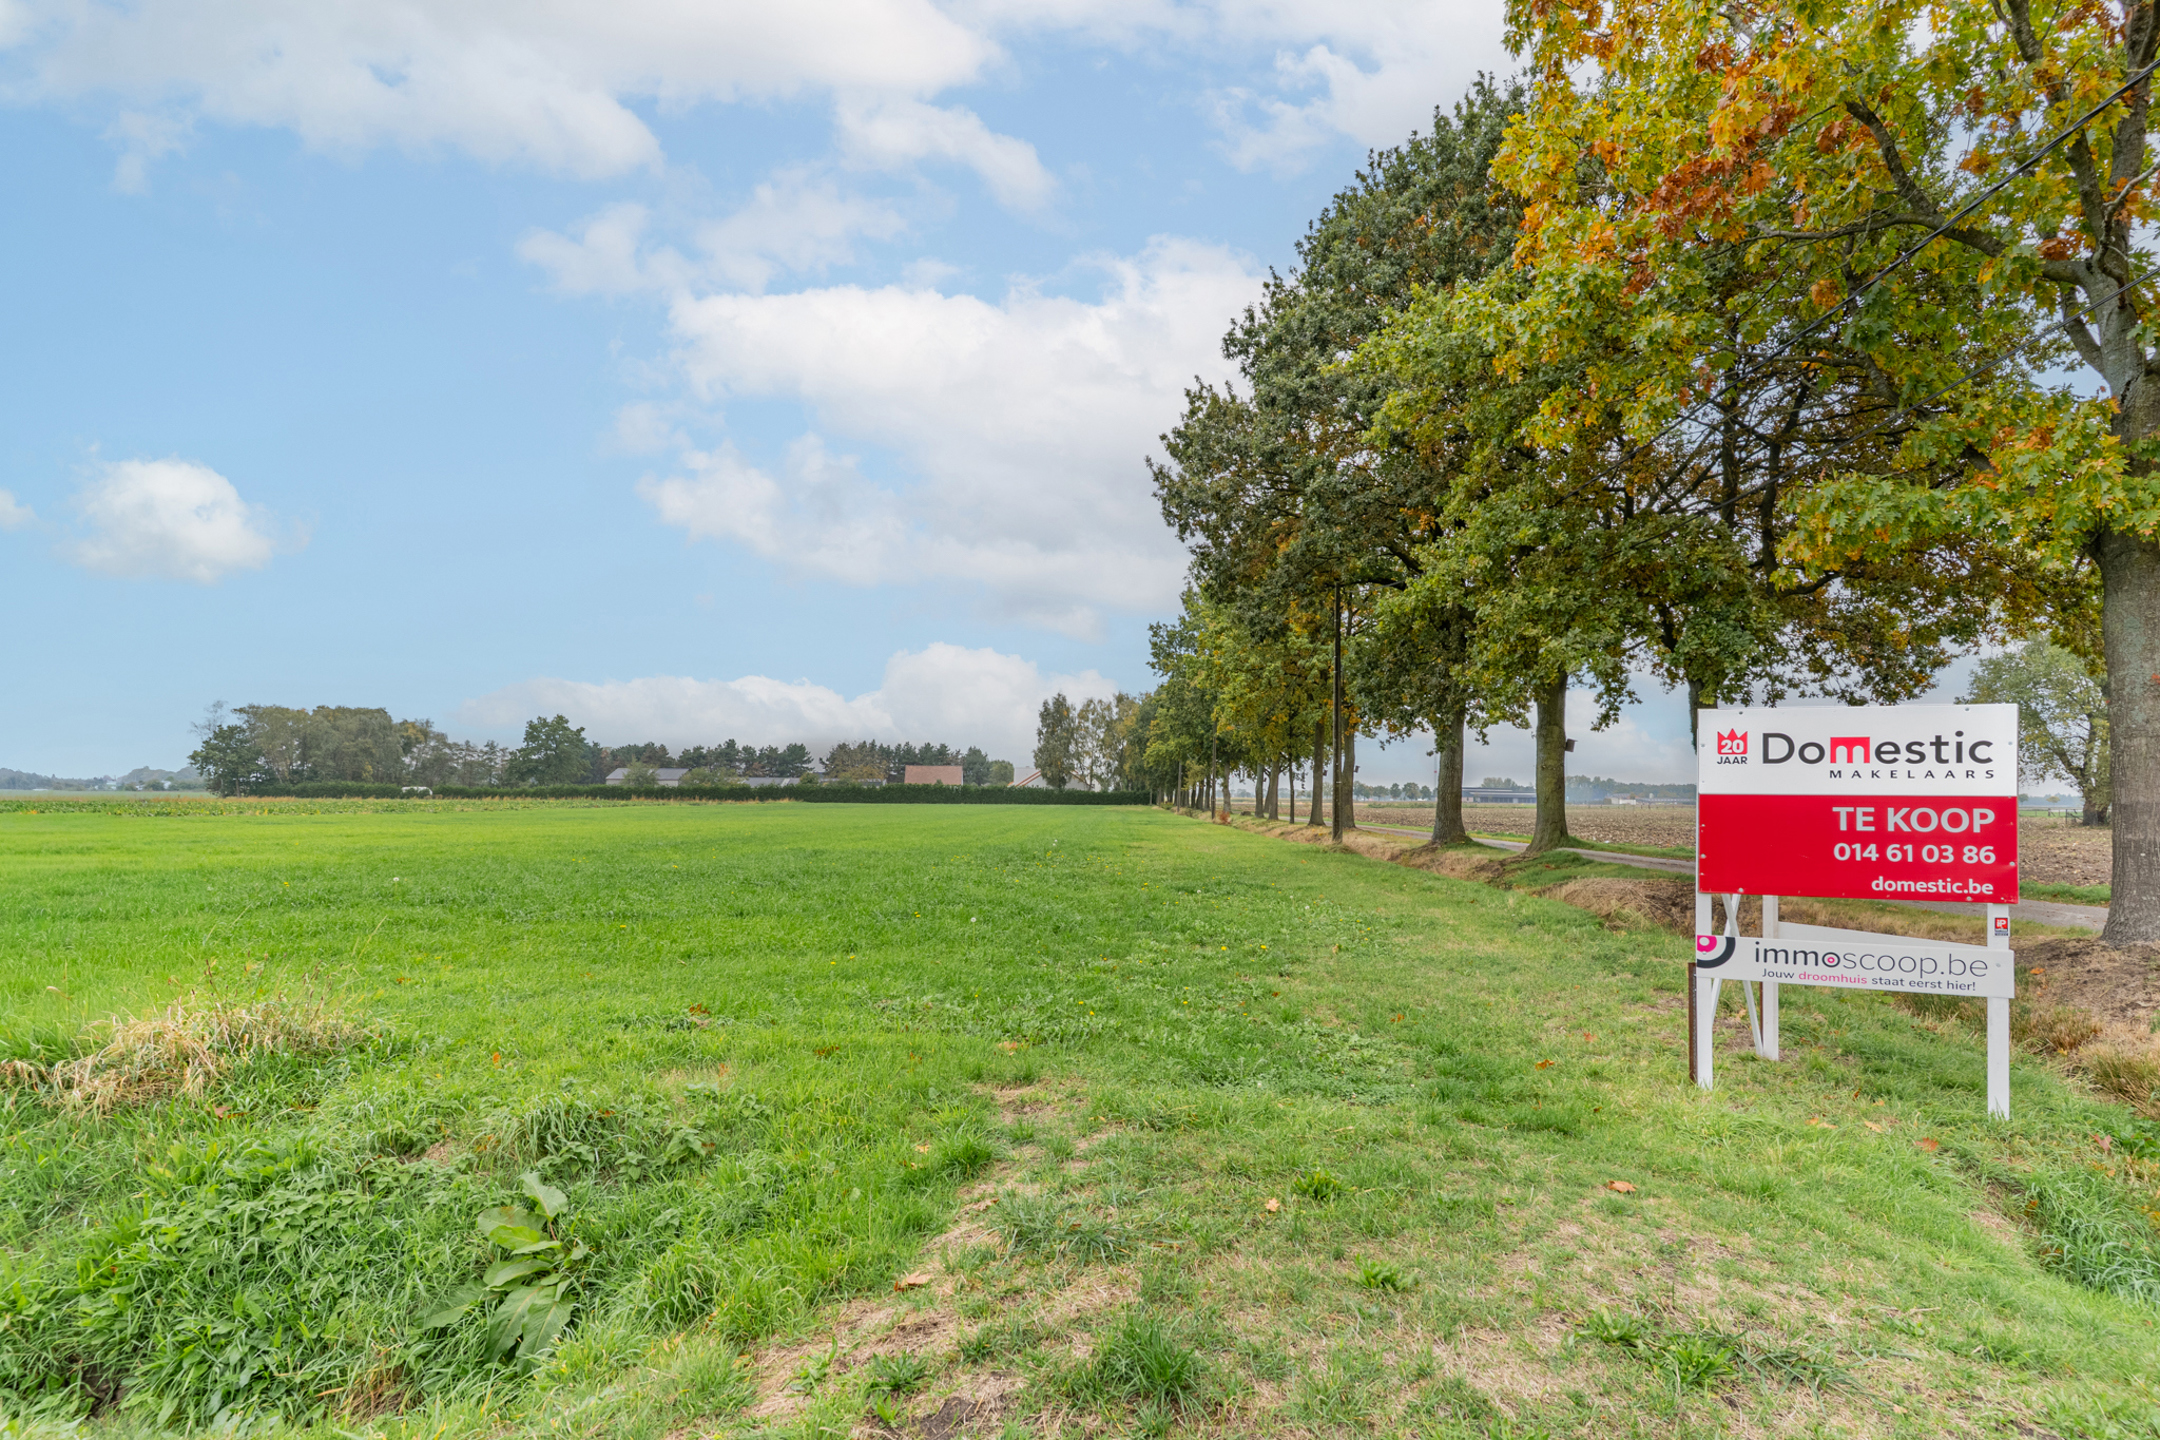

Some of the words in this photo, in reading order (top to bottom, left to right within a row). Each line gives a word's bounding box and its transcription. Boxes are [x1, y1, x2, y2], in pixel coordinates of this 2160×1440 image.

[1721, 739, 1744, 753] 20
[1762, 730, 1993, 764] Domestic
[1717, 756, 1748, 765] JAAR
[1829, 769, 1994, 779] MAKELAARS
[1832, 806, 1875, 831] TE
[1888, 807, 1995, 833] KOOP
[1833, 843, 1879, 861] 014
[1886, 844, 1913, 862] 61
[1922, 844, 1954, 863] 03
[1963, 845, 1996, 864] 86
[1871, 876, 1994, 895] domestic.be
[1755, 941, 1988, 979] immoscoop.be
[1762, 968, 1795, 979] Jouw
[1798, 971, 1868, 985] droomhuis
[1871, 976, 1905, 986] staat
[1908, 979, 1943, 989] eerst
[1946, 980, 1976, 991] hier!
